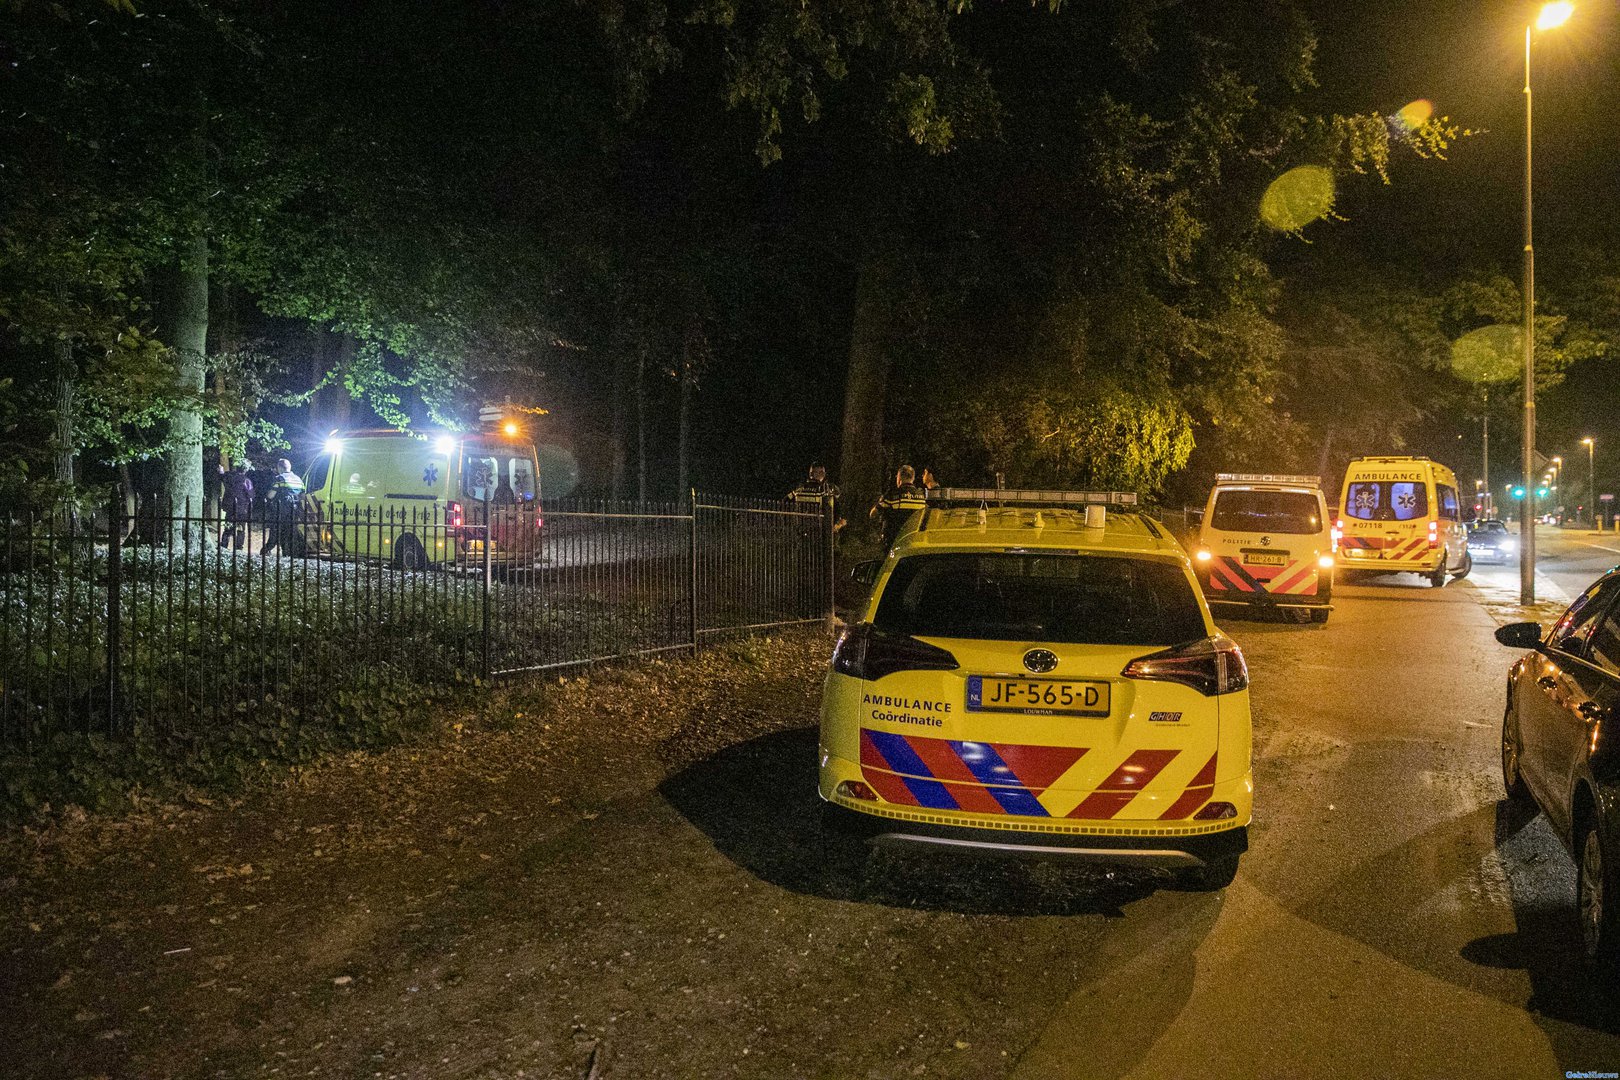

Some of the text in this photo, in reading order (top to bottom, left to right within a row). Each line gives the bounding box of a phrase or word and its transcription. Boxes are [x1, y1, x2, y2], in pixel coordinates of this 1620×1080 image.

[1354, 473, 1422, 481] AMBULANCE
[334, 507, 378, 518] AMBUANCE
[990, 683, 1100, 707] JF-565-D
[863, 693, 952, 713] AMBULANCE
[871, 709, 943, 727] Coördinatie
[1149, 712, 1182, 721] GHOR
